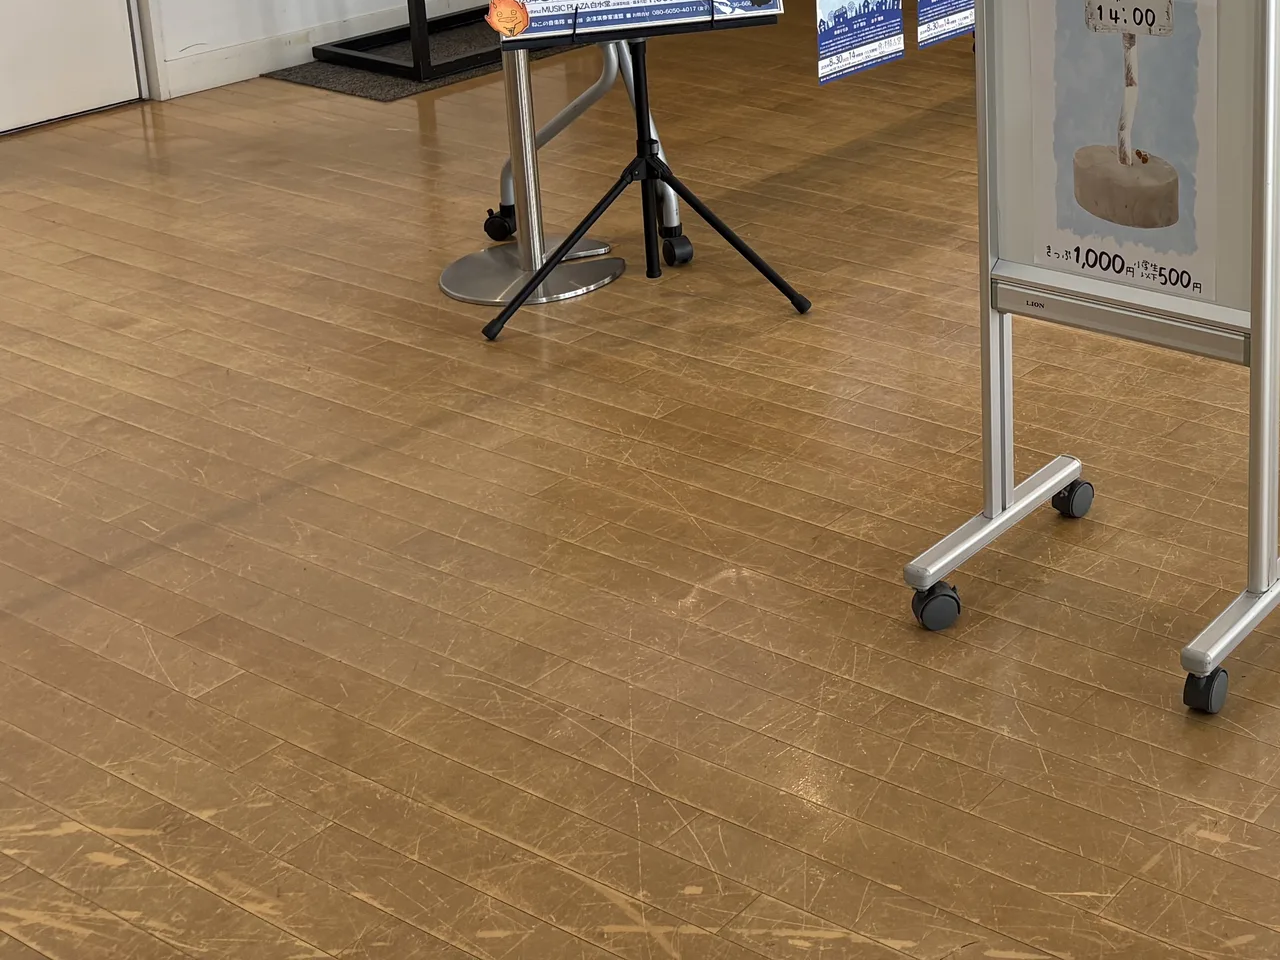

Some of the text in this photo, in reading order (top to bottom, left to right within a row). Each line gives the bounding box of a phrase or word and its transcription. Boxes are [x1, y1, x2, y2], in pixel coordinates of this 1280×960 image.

[541, 5, 566, 13] MUSIC
[566, 2, 591, 12] PLAZA
[1097, 4, 1156, 27] 14:00
[1046, 245, 1135, 278] きっぷ 1,000円
[1133, 259, 1159, 272] 小学生
[1141, 267, 1202, 293] 以下 500円
[1026, 300, 1045, 309] LION
